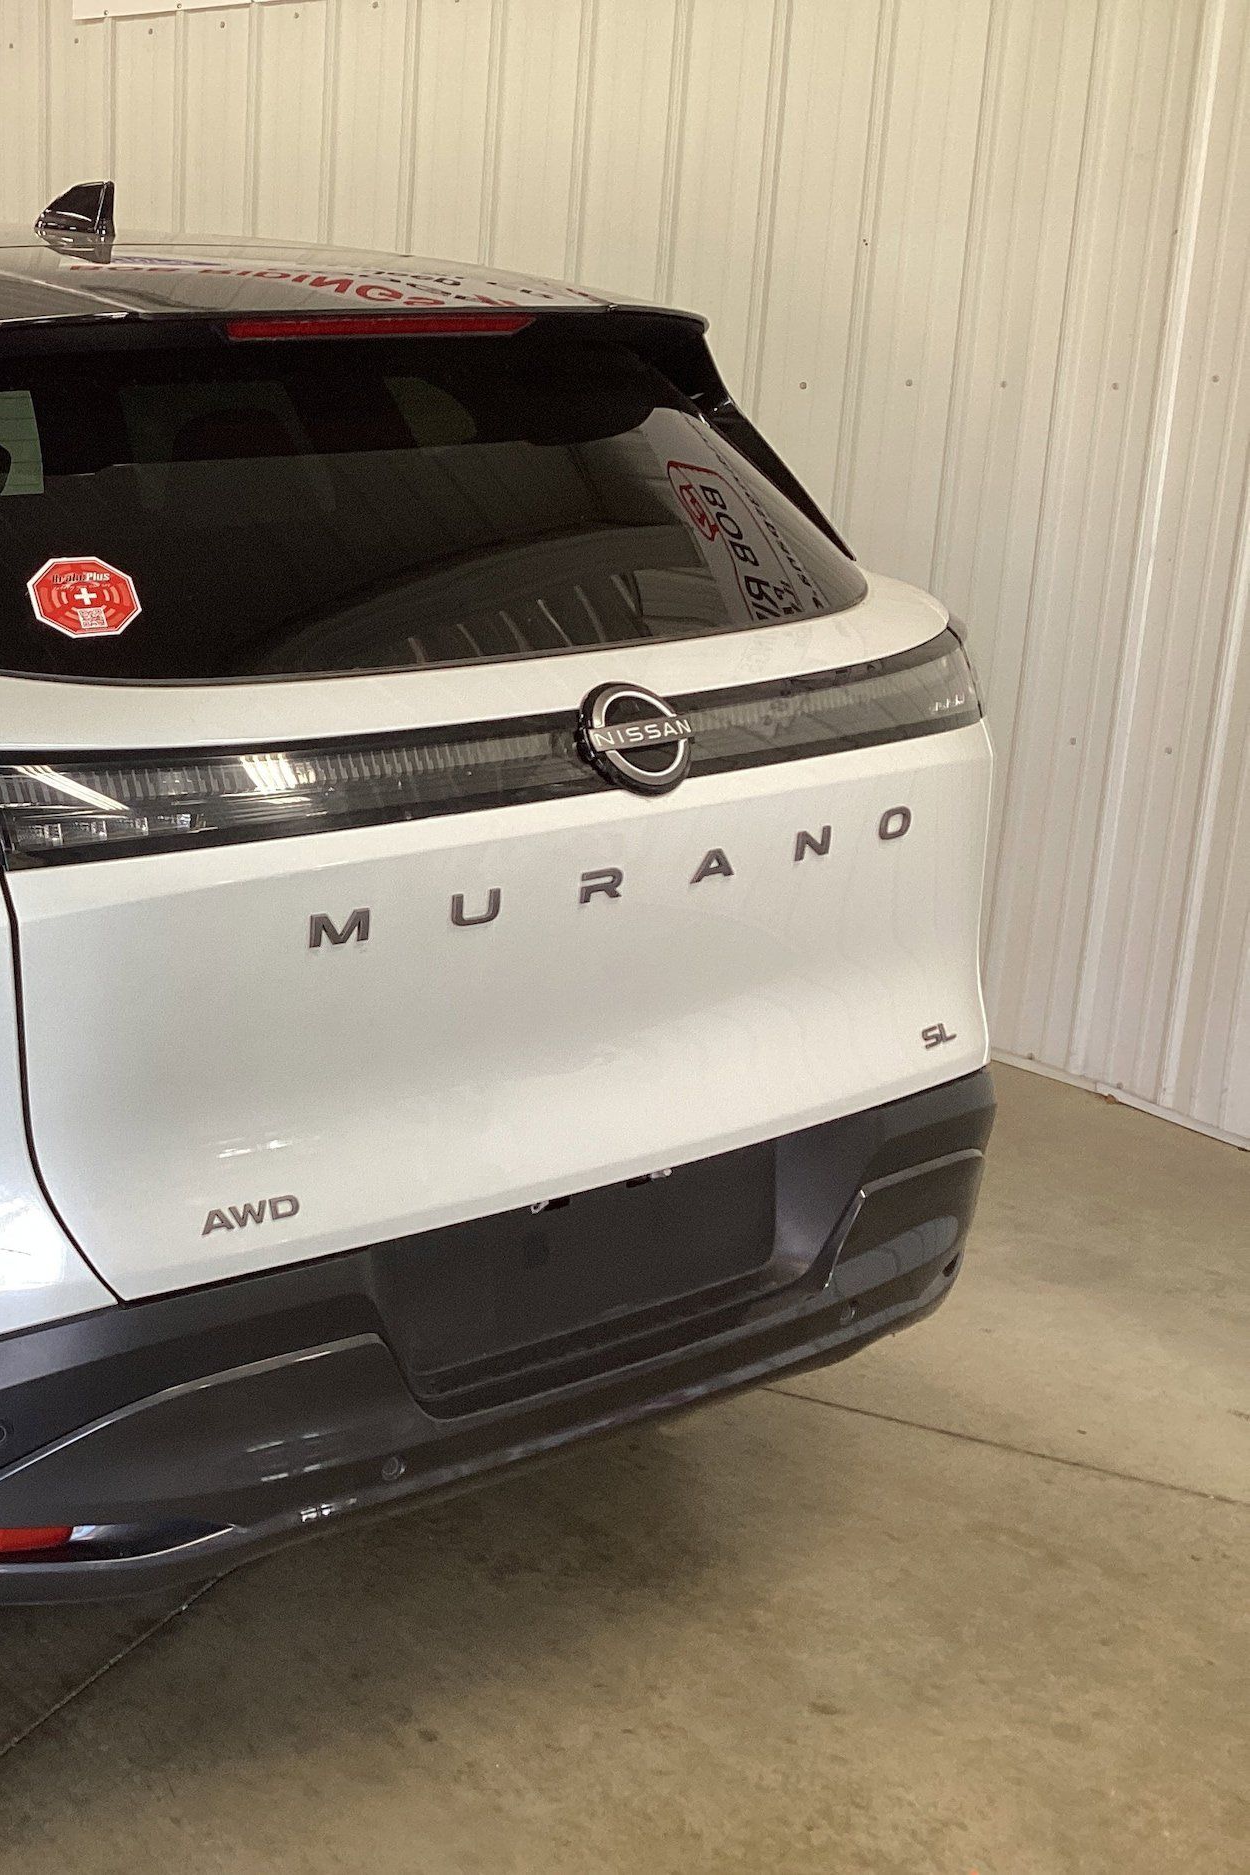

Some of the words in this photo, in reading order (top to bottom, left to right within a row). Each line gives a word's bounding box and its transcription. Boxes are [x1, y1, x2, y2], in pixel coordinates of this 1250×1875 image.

[593, 719, 692, 747] NISSAN
[309, 805, 912, 948] MURANO
[921, 1022, 957, 1050] SL
[201, 1194, 300, 1236] AWD
